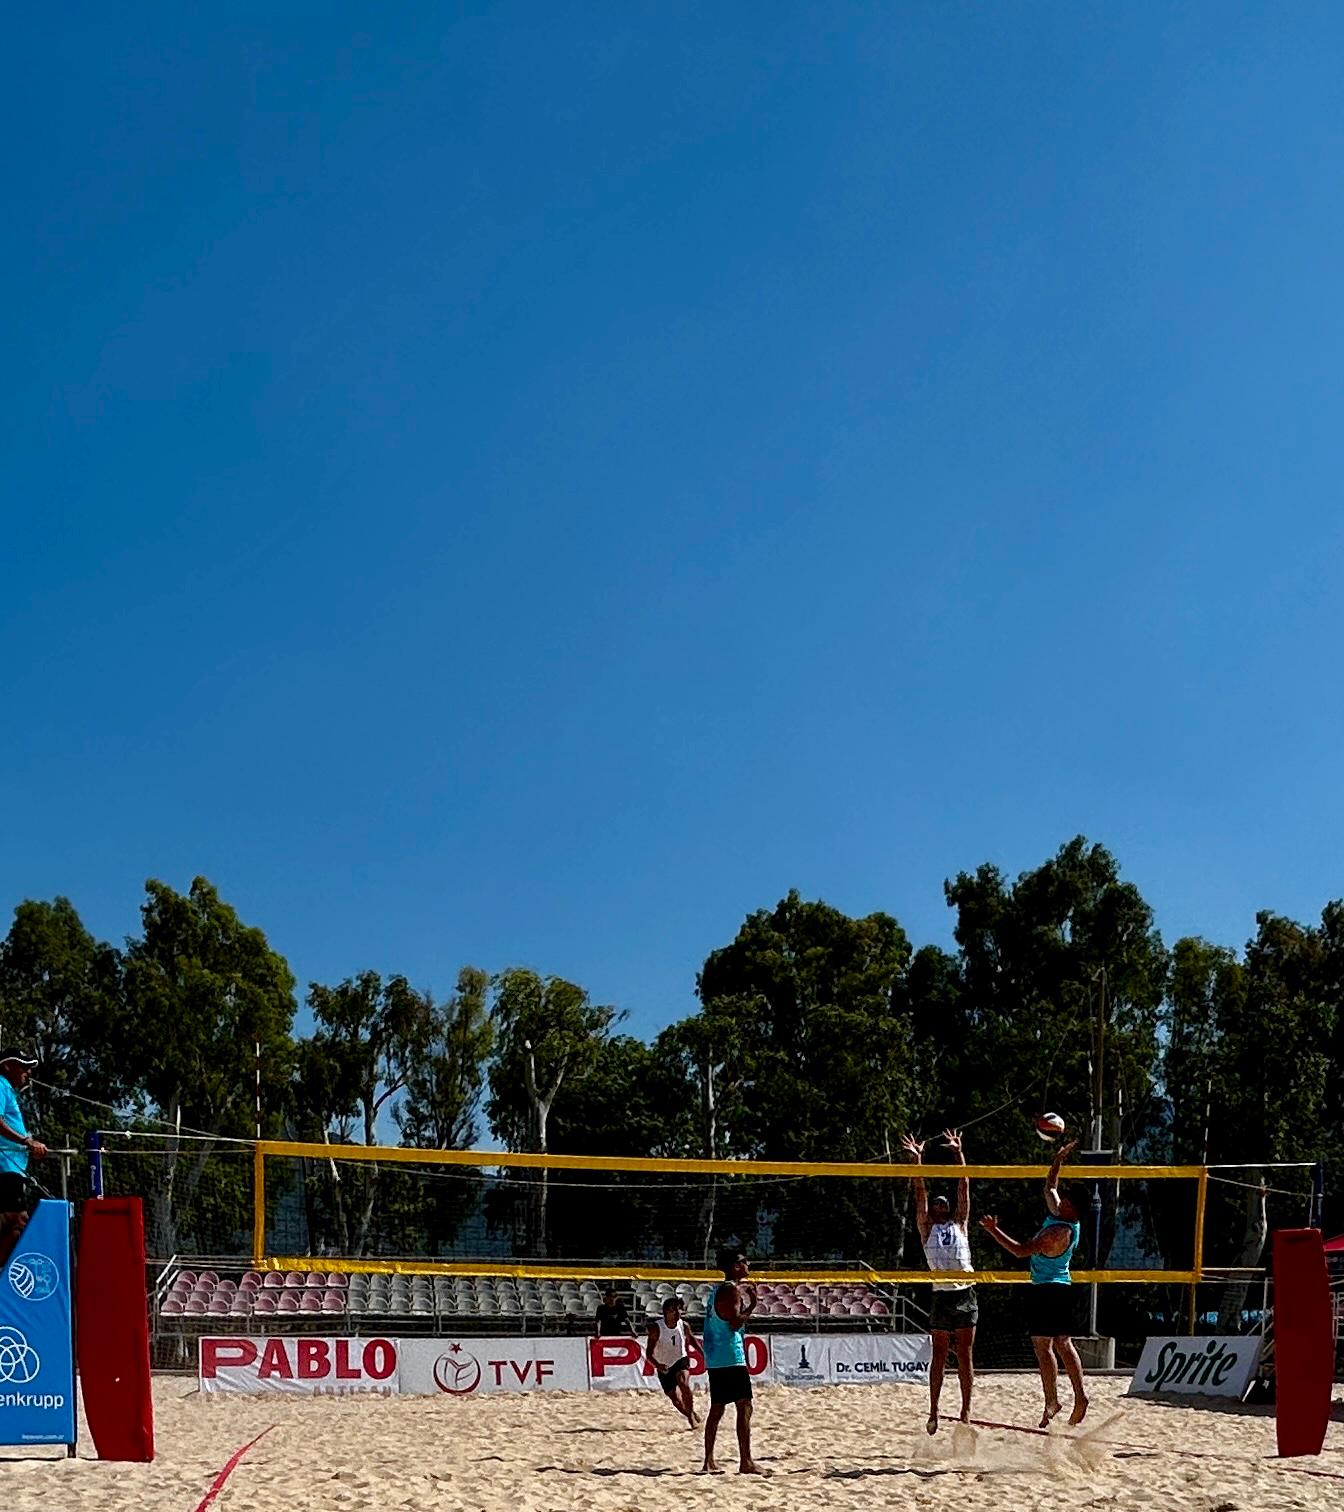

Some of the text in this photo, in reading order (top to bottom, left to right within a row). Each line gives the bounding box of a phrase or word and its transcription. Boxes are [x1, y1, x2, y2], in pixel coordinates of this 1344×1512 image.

[201, 1338, 397, 1380] PABLO
[488, 1360, 554, 1385] TVF
[836, 1359, 929, 1373] Dr. CEMİL TUGAY
[1145, 1339, 1238, 1392] Sprite
